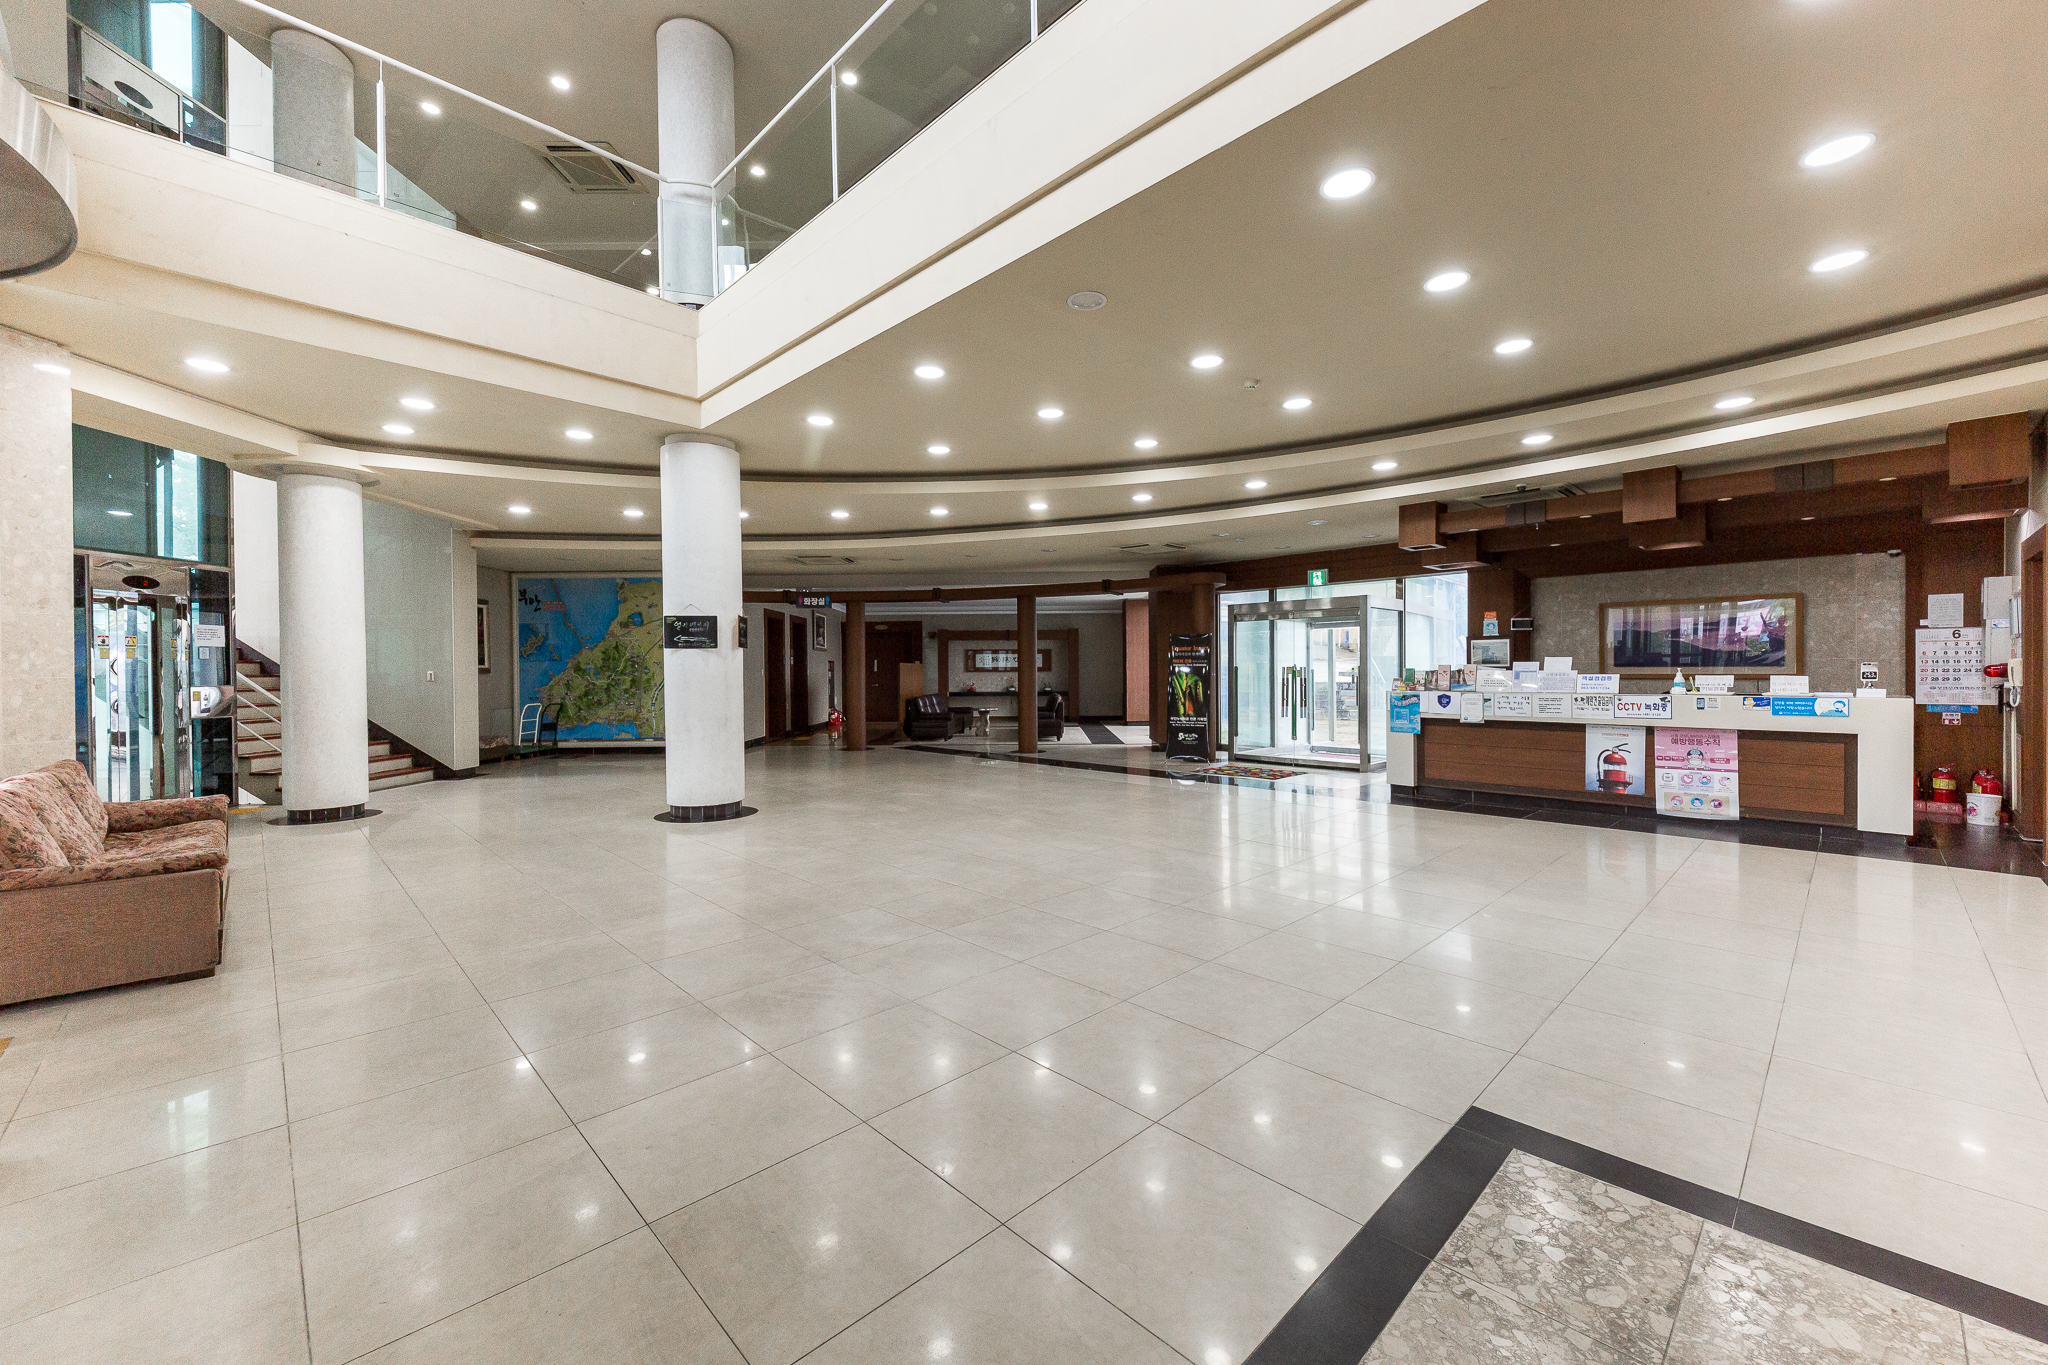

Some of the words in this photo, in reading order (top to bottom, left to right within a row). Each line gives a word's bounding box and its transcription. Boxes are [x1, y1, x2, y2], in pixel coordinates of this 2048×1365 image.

[518, 588, 541, 612] 부안
[803, 597, 825, 606] 화장실
[1952, 629, 1961, 639] 6
[1616, 702, 1642, 711] CCTV
[1644, 702, 1668, 712] 녹화중
[1670, 737, 1721, 746] 예방행동수칙
